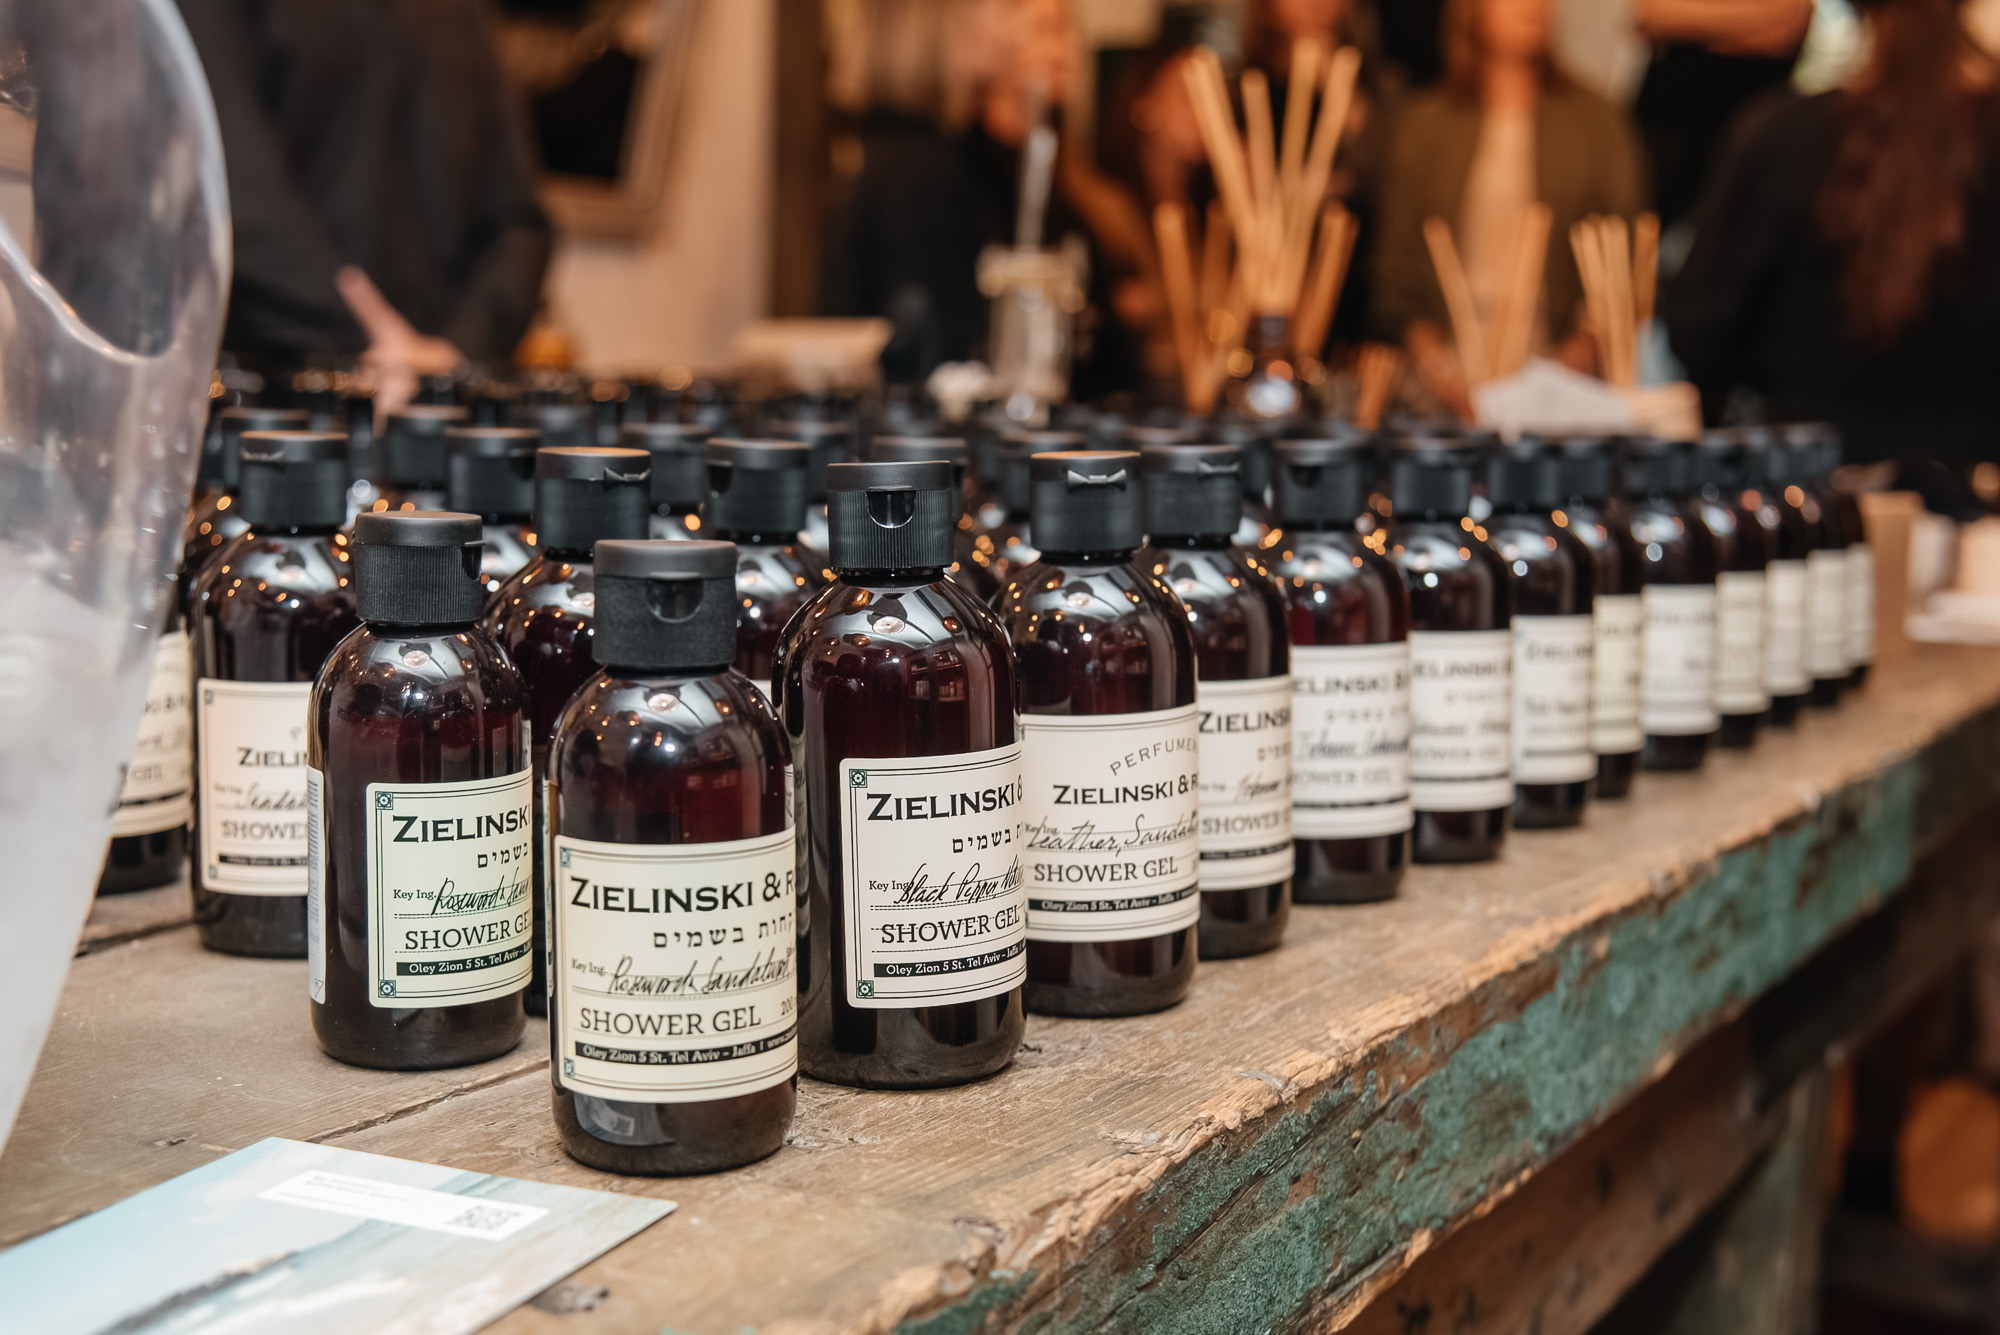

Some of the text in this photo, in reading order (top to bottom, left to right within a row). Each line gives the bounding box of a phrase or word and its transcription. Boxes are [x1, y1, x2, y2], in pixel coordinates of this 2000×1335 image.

[867, 782, 1015, 822] ZIELINSKI
[1053, 780, 1173, 805] ZIELINSKI
[1178, 774, 1189, 795] &
[869, 880, 889, 892] Key
[894, 863, 956, 904] Black
[1034, 856, 1178, 883] SHOWER GEL
[393, 889, 414, 901] Key
[571, 875, 754, 914] ZIELINSKI
[762, 872, 781, 902] &
[1041, 901, 1064, 912] Oley
[1066, 901, 1089, 911] Zion
[1114, 899, 1129, 909] Tel
[405, 919, 511, 950] SHOWER
[653, 926, 744, 949] בשמים
[881, 904, 1020, 943] SHOWER GEL
[409, 963, 435, 975] Oley
[438, 961, 463, 973] Zion
[466, 959, 472, 969] 5
[474, 956, 488, 968] St.
[489, 953, 502, 965] Tel
[887, 964, 912, 977] Oley
[915, 963, 940, 975] Zion
[942, 961, 949, 971] 5
[952, 959, 965, 970] St.
[967, 957, 981, 968] Tel
[982, 953, 1001, 965] Aviv
[581, 1007, 704, 1035] SHOWER
[713, 1005, 762, 1032] GEL
[583, 1044, 606, 1061] Oley
[609, 1047, 636, 1062] Zion
[638, 1050, 646, 1062] 5
[649, 1051, 667, 1063] St.
[670, 1050, 688, 1063] Tel
[692, 1048, 720, 1062] Aviv
